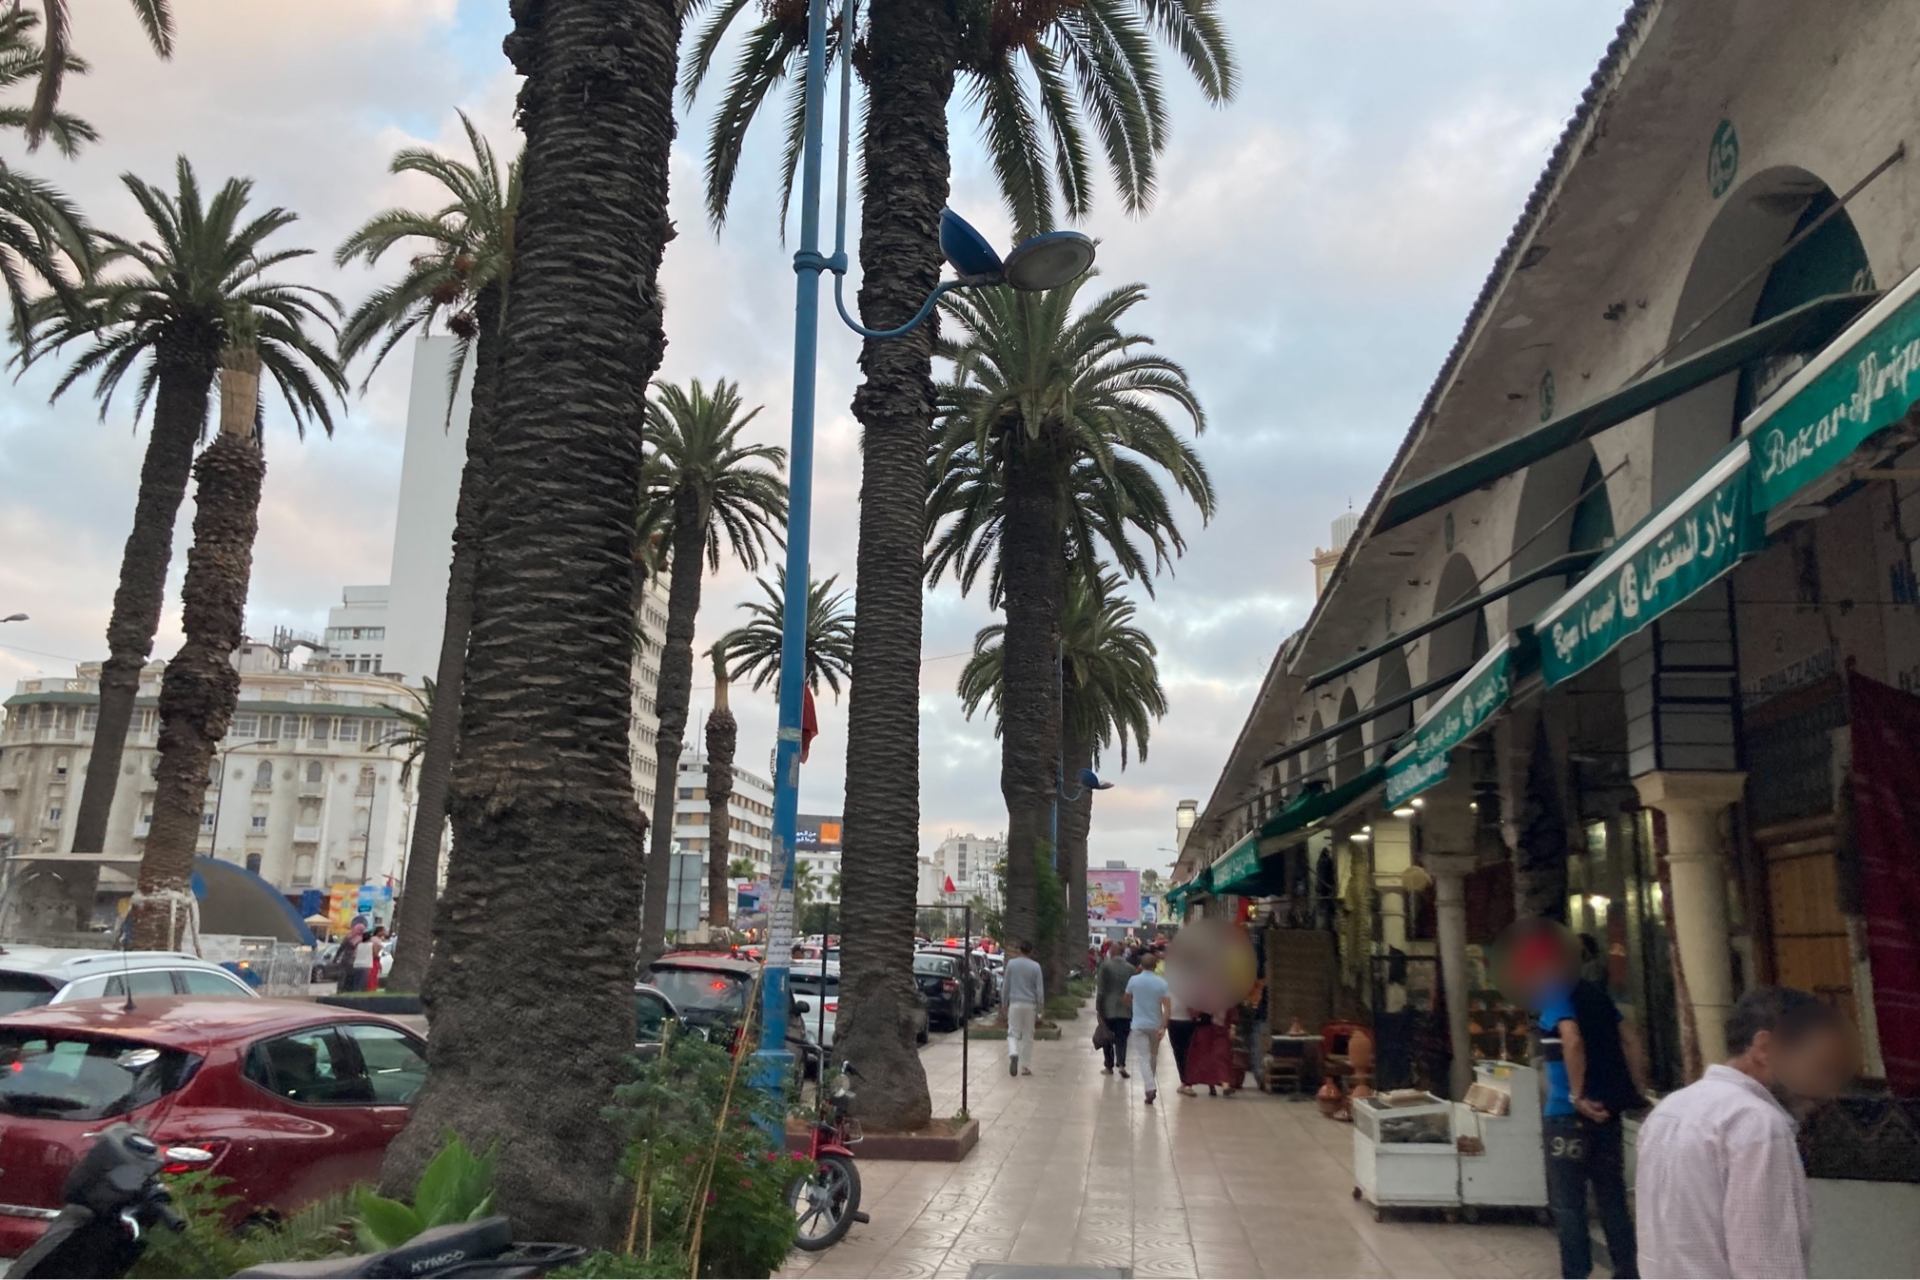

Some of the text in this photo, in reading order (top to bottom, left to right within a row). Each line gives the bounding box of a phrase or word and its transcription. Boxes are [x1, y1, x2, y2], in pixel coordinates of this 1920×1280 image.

[1761, 403, 1846, 483] Bazar
[1551, 1135, 1584, 1159] 96
[411, 1249, 465, 1272] KYMCO
